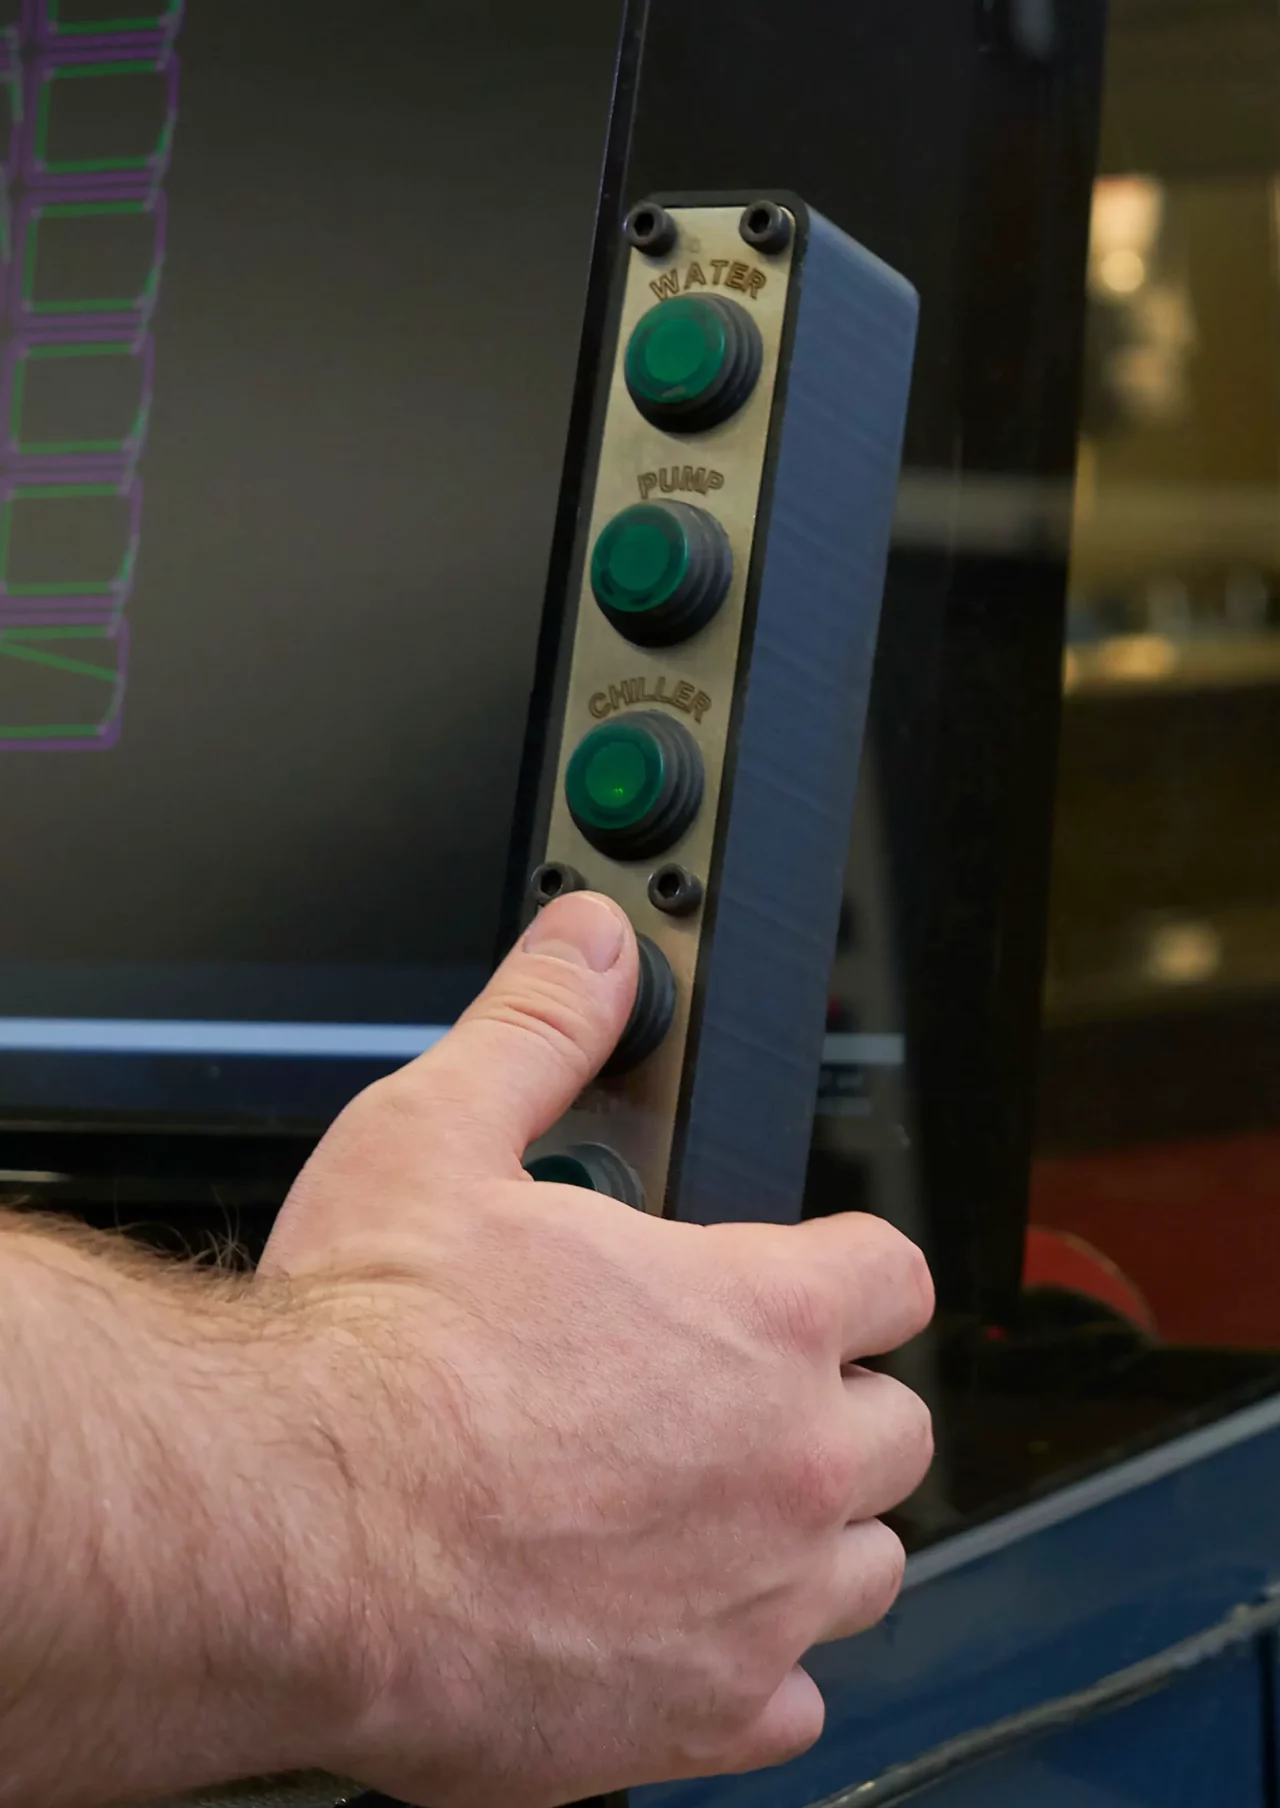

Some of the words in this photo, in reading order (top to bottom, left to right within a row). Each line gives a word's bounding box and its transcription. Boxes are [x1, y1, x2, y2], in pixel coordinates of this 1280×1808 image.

[649, 259, 767, 301] WATER
[637, 464, 724, 500] PUMP
[588, 676, 712, 725] CHILLER
